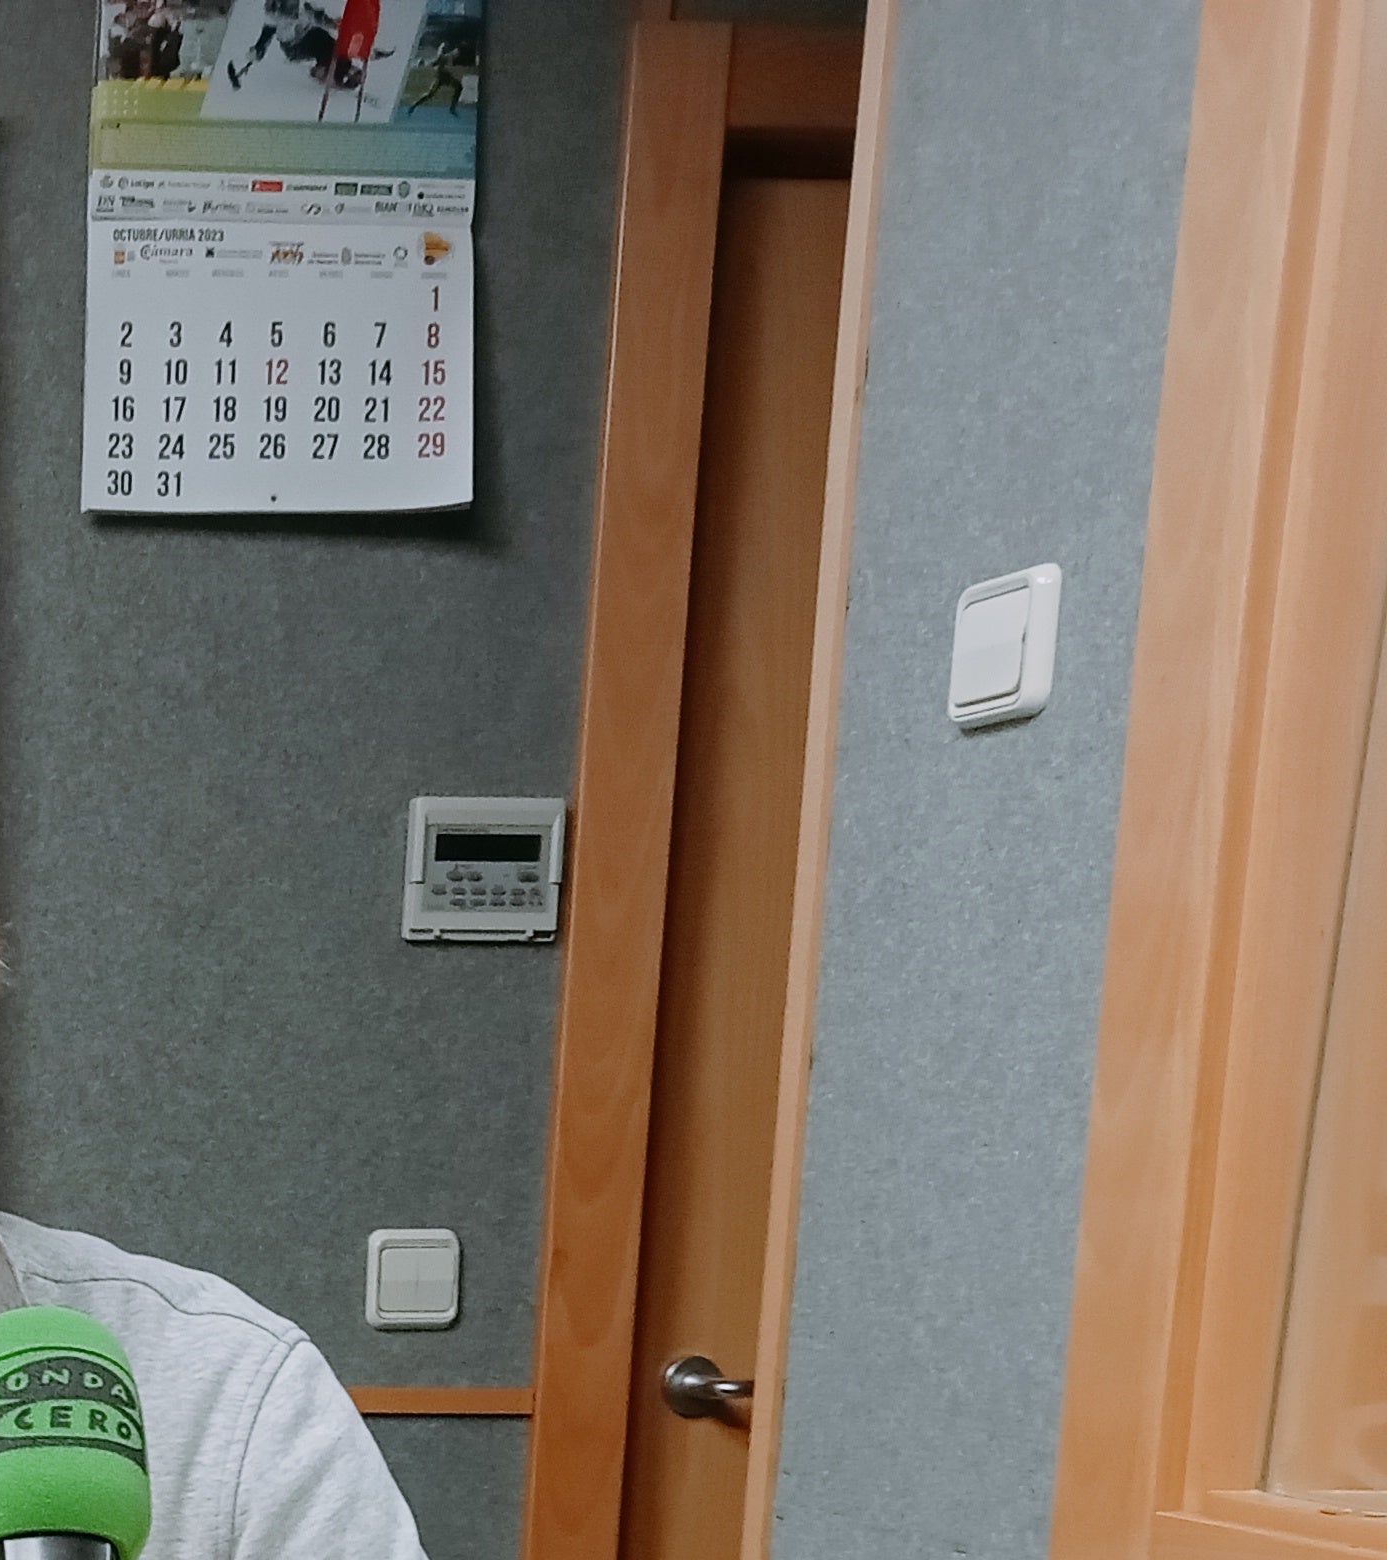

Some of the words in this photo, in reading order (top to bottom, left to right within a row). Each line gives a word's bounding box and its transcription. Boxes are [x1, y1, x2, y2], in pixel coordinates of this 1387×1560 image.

[198, 228, 225, 242] 2023
[431, 284, 440, 313] 1
[120, 321, 134, 348] 2
[169, 321, 183, 348] 3
[219, 321, 233, 348] 4
[270, 321, 284, 348] 5
[322, 321, 336, 348] 6
[373, 322, 387, 349] 7
[426, 321, 440, 349] 8
[119, 358, 132, 386] 9
[164, 358, 188, 386] 10
[215, 358, 237, 386] 11
[265, 358, 290, 386] 12
[318, 358, 342, 386] 13
[368, 359, 393, 387] 14
[421, 359, 446, 387] 15
[111, 396, 135, 423] 16
[162, 396, 187, 423] 17
[212, 396, 237, 423] 18
[262, 395, 287, 423] 19
[313, 395, 340, 423] 20
[363, 396, 391, 424] 21
[418, 396, 446, 423] 22
[107, 433, 134, 460] 23
[157, 433, 185, 461] 24
[208, 433, 235, 460] 25
[259, 433, 286, 460] 26
[312, 433, 340, 460] 27
[363, 433, 390, 460] 28
[417, 431, 446, 460] 29
[106, 470, 133, 497] 30
[156, 470, 182, 498] 31
[6, 1368, 129, 1403] ONDA
[13, 1405, 133, 1441] CERO
